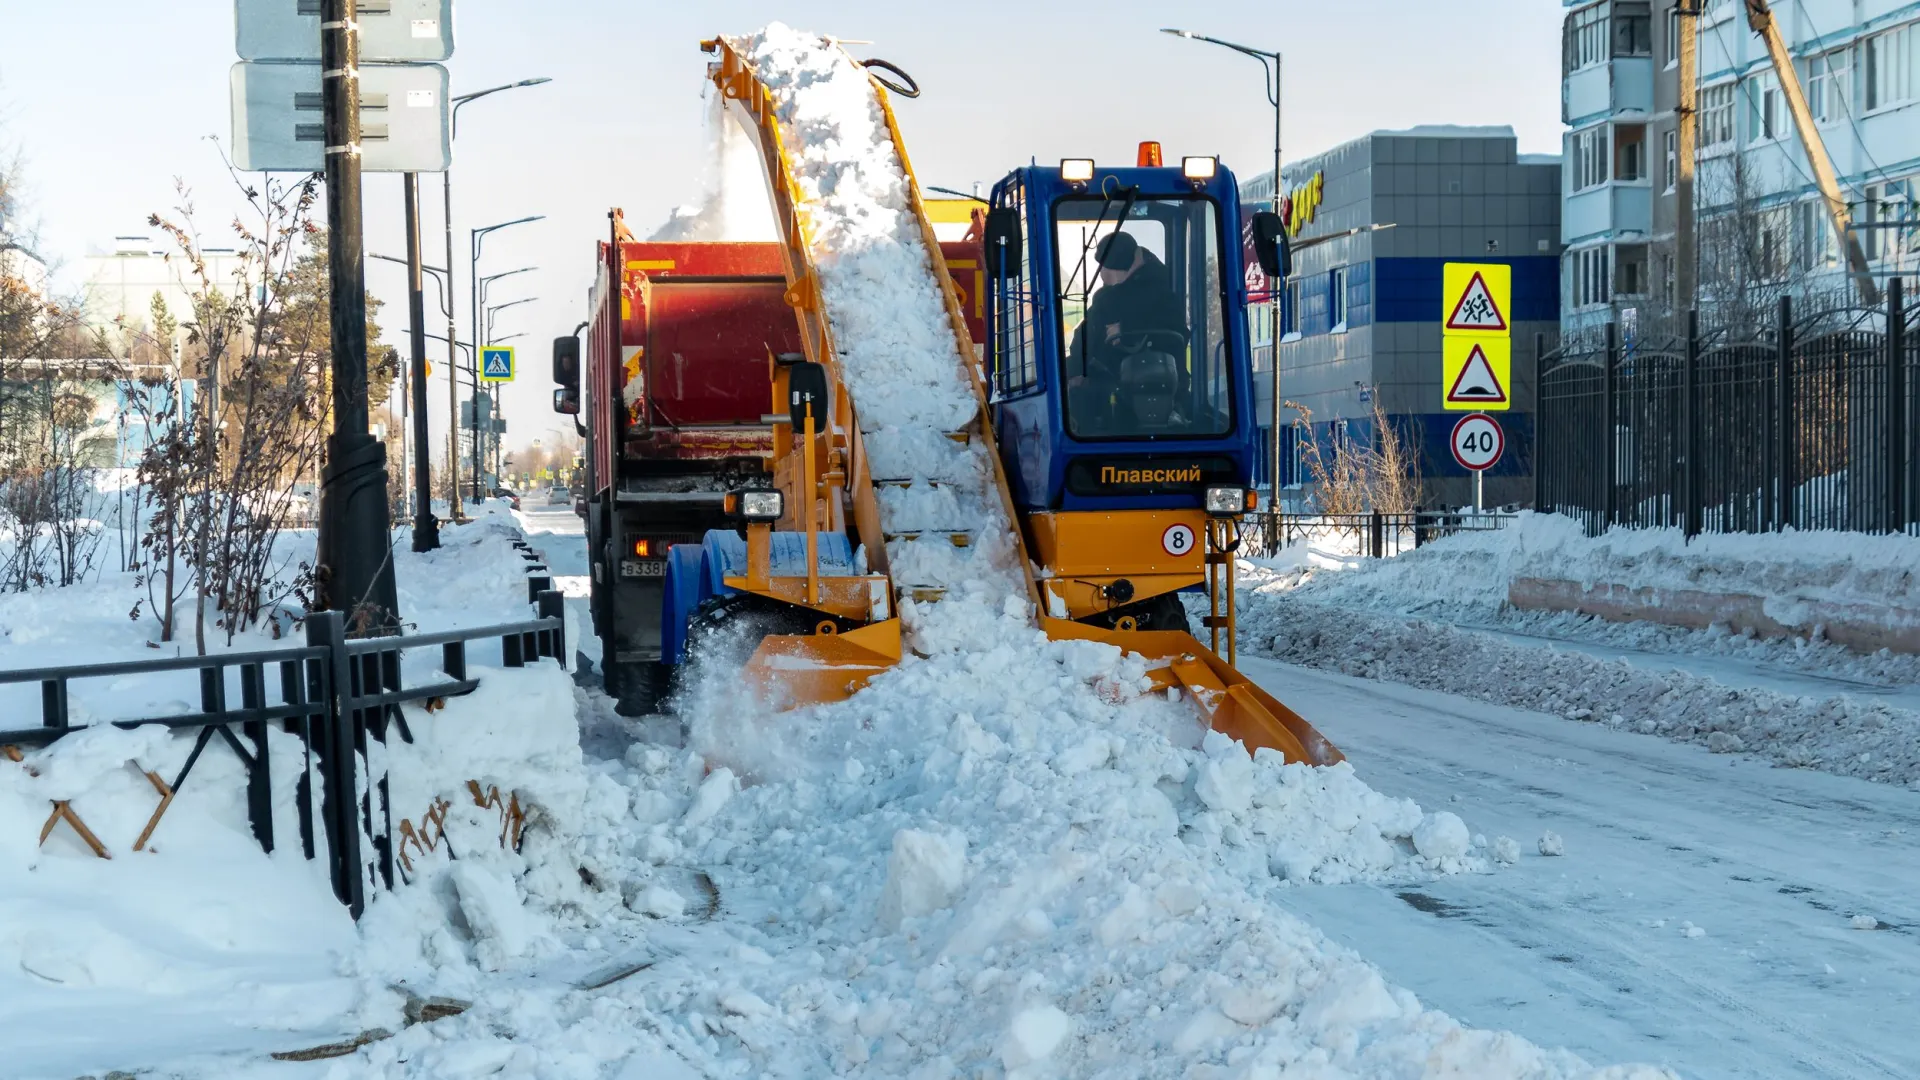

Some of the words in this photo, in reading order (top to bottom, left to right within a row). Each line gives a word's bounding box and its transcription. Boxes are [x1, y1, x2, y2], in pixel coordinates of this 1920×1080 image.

[1462, 431, 1493, 453] 40
[1101, 465, 1201, 483] Плавский
[1172, 531, 1185, 549] 8
